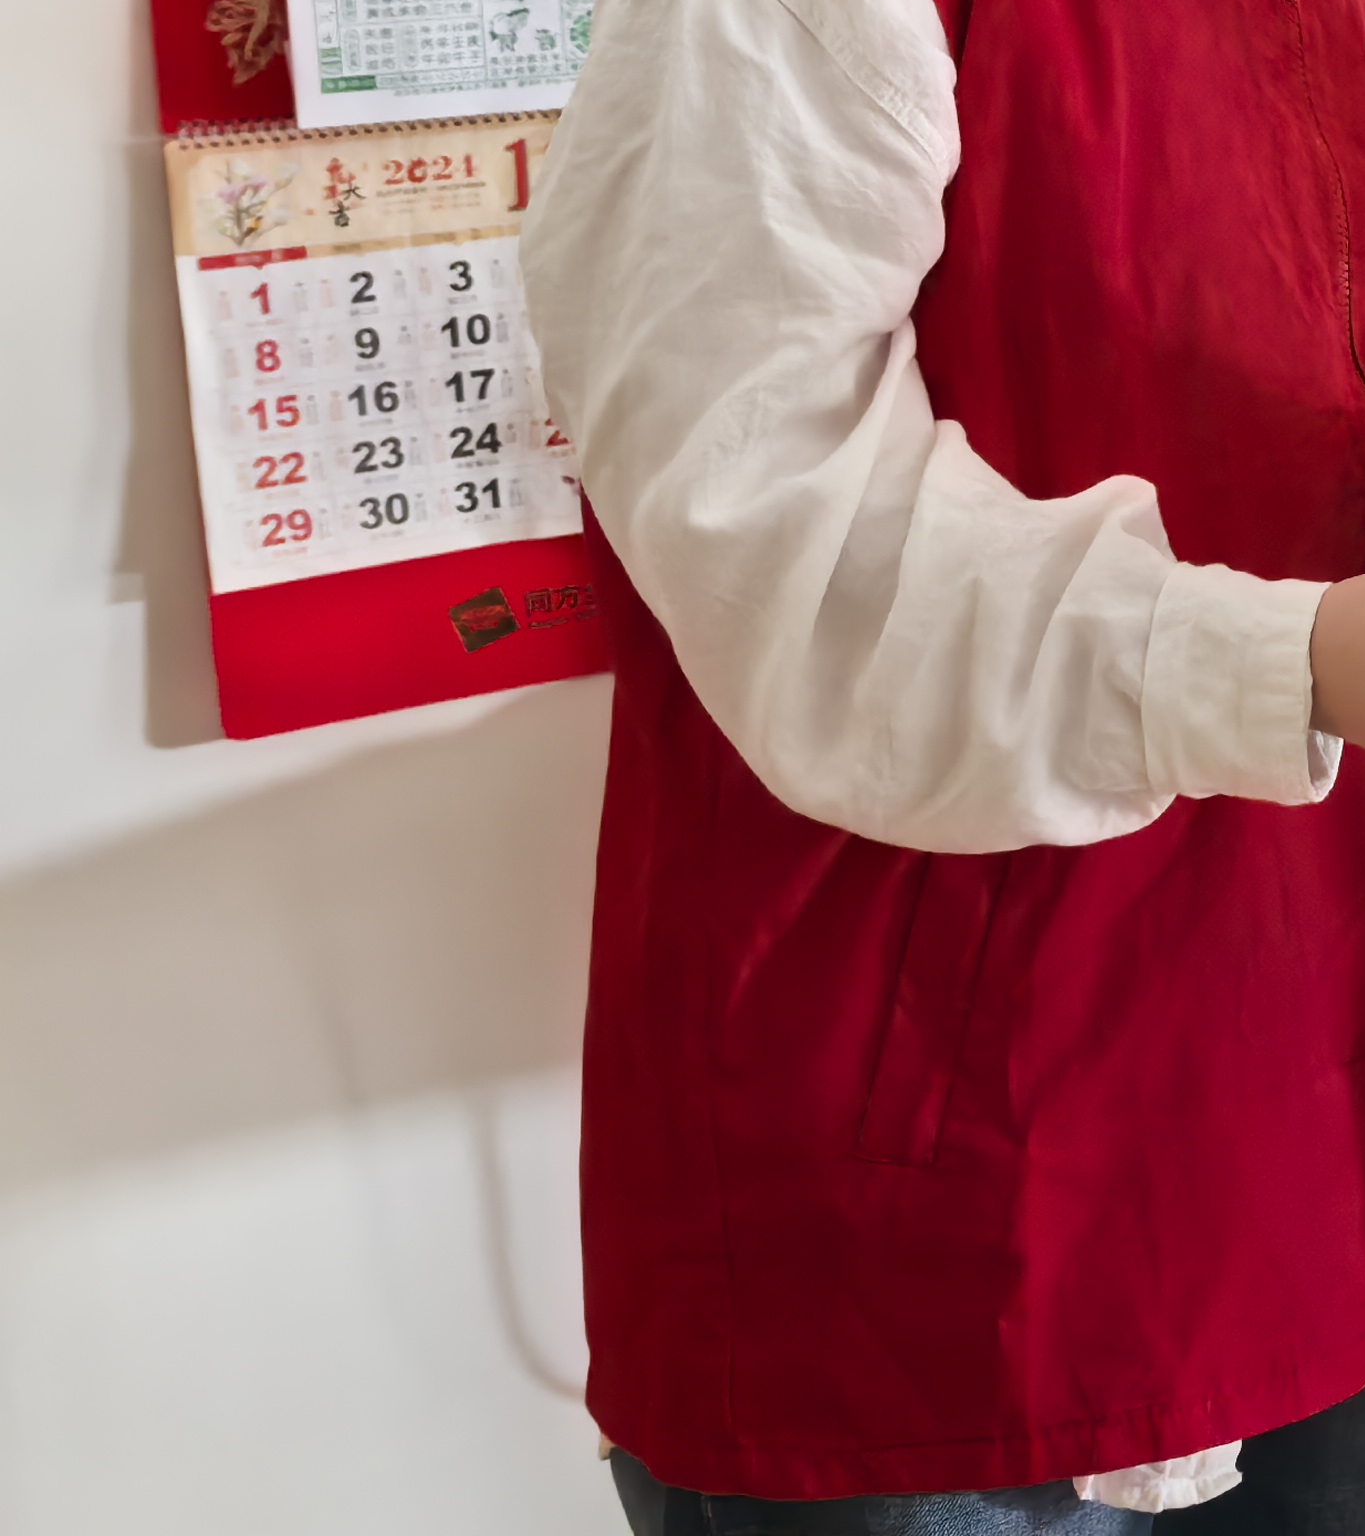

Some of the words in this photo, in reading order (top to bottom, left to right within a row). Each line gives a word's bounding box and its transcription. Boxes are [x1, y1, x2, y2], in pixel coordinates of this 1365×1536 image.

[252, 283, 271, 315] 1
[350, 271, 375, 304] 2
[449, 261, 474, 292] 3
[256, 340, 280, 372] 8
[355, 328, 380, 360] 9
[441, 313, 490, 347] 10
[248, 395, 300, 430] 15
[348, 381, 399, 416] 16
[446, 369, 495, 403] 17
[254, 452, 307, 489] 22
[353, 437, 404, 474] 23
[450, 423, 502, 459] 24
[261, 510, 312, 547] 29
[359, 493, 409, 530] 30
[455, 478, 501, 513] 31
